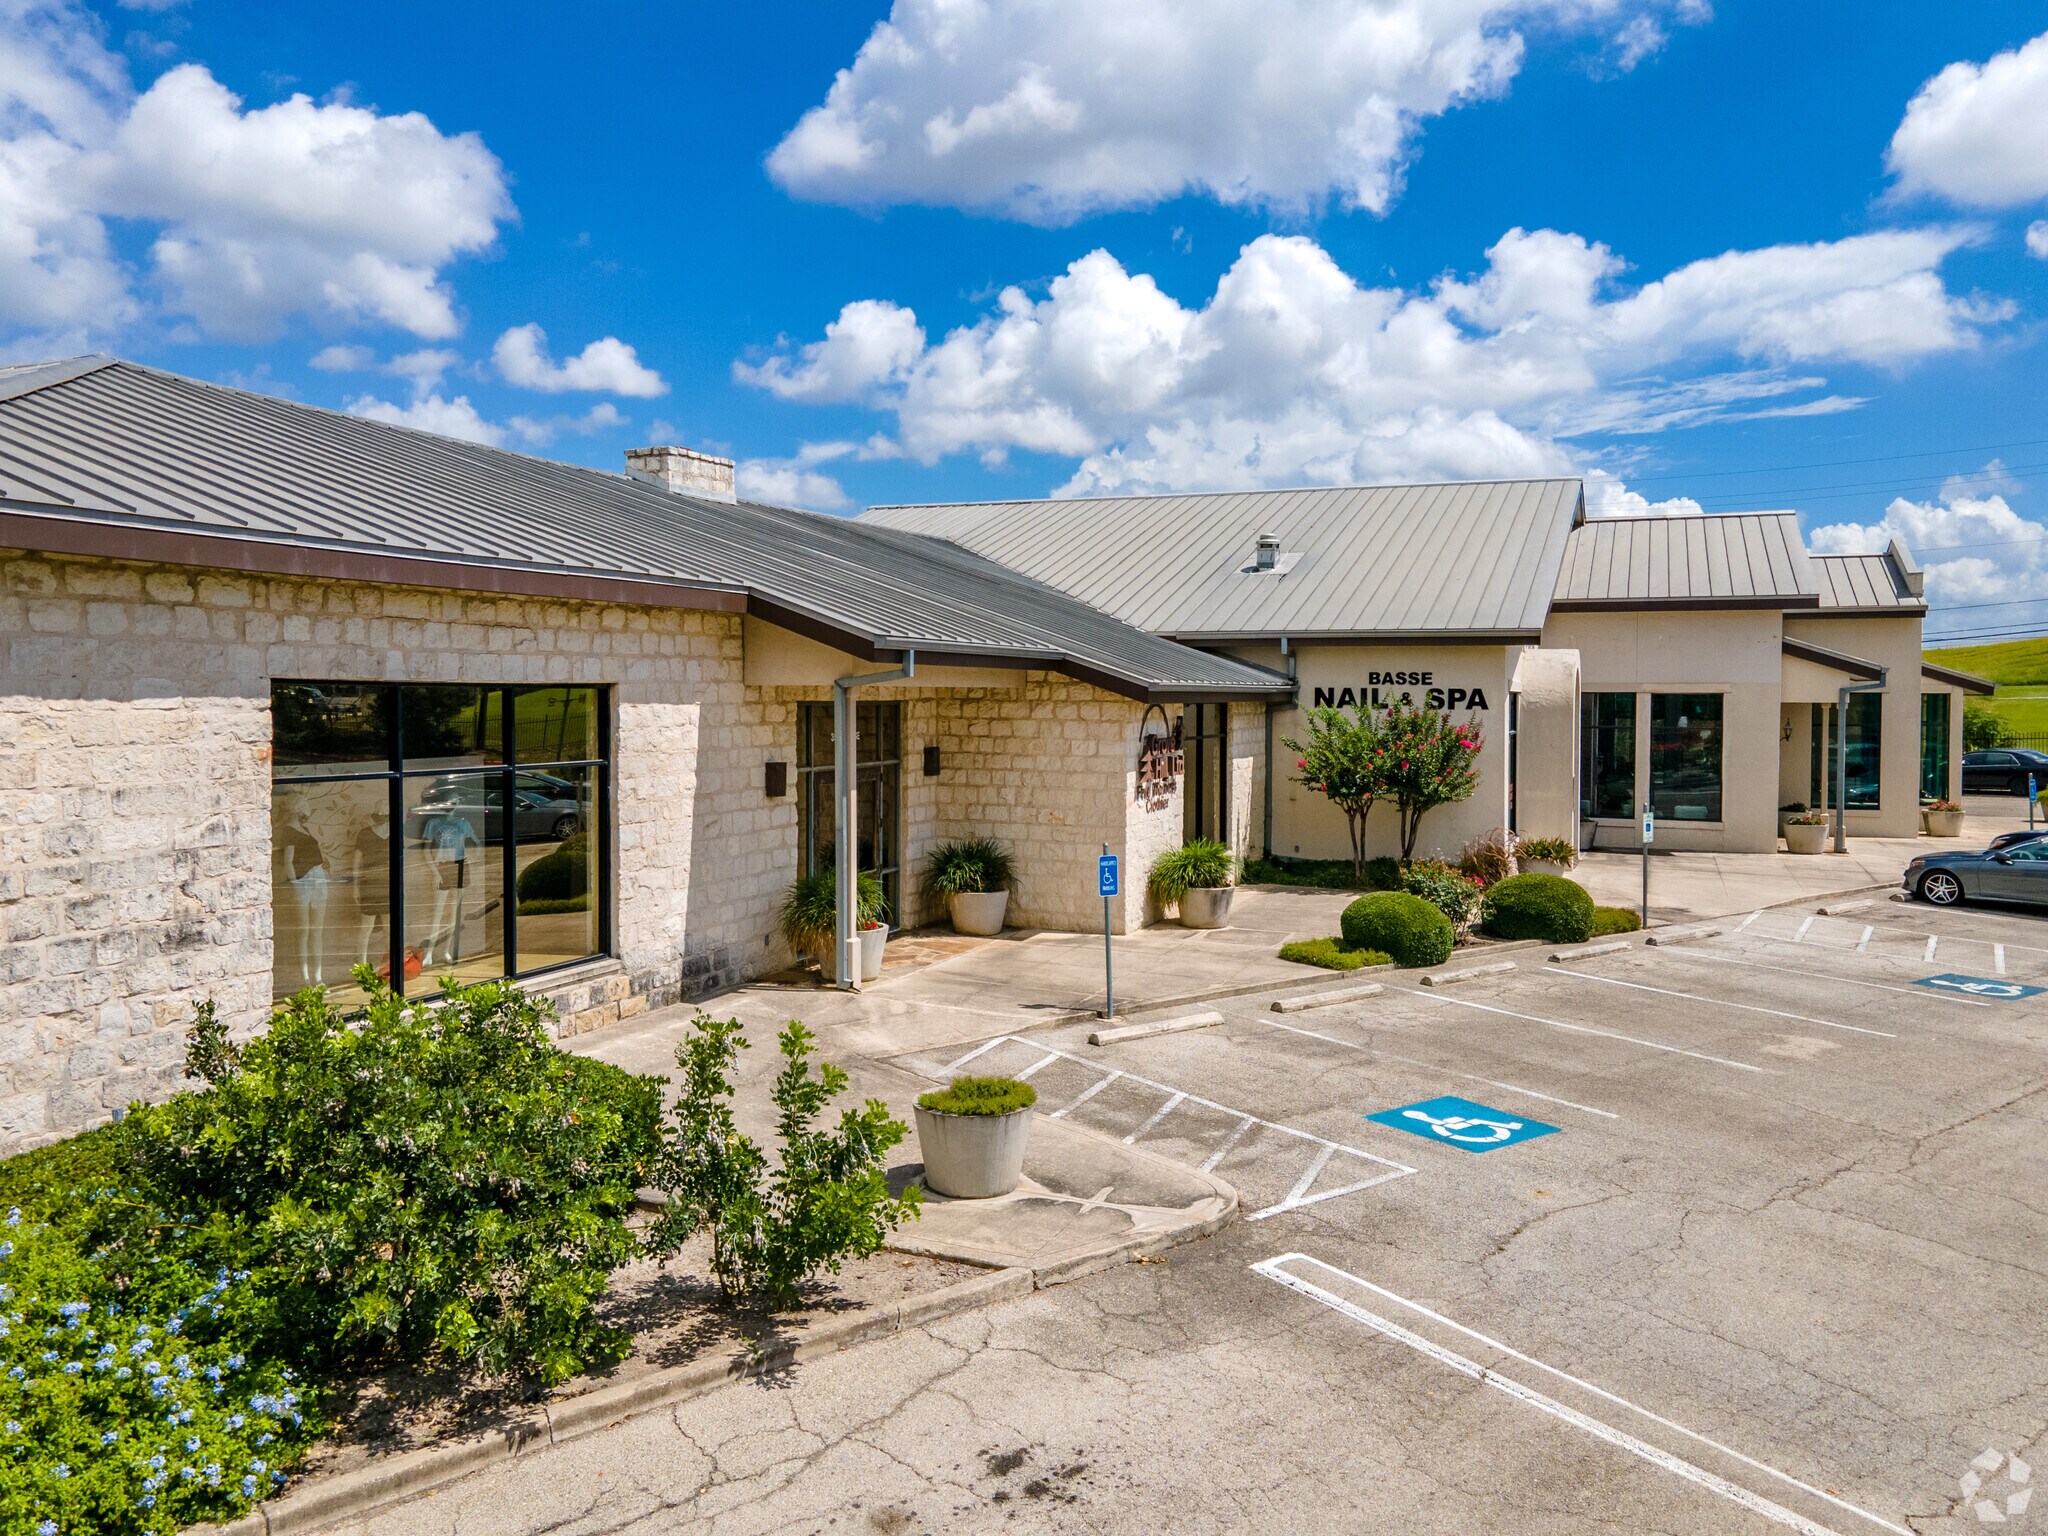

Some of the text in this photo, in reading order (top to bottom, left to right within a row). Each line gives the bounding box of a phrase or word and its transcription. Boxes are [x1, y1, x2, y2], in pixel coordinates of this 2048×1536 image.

[1368, 672, 1433, 685] BASSE
[1314, 687, 1489, 710] NAIL & SPA
